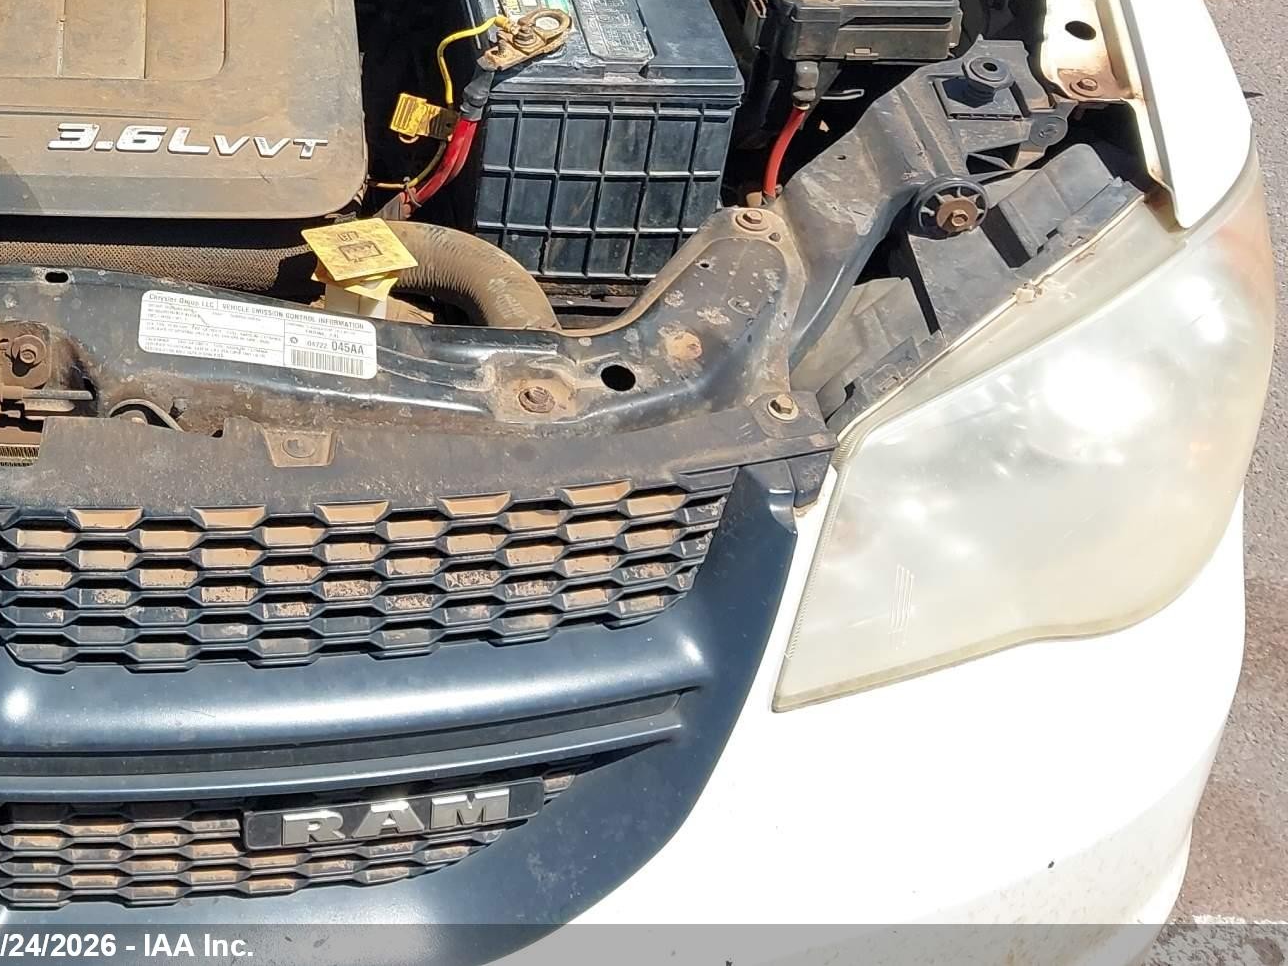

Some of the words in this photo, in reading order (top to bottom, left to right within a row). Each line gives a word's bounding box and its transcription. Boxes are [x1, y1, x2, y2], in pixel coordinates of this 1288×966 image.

[149, 294, 177, 303] Chrysler
[202, 300, 214, 308] LLC
[222, 303, 249, 313] VEHICLE
[252, 307, 284, 318] EMISSION
[285, 312, 316, 322] CONTROL
[318, 316, 364, 329] INFORMATION
[281, 788, 510, 846] RAM
